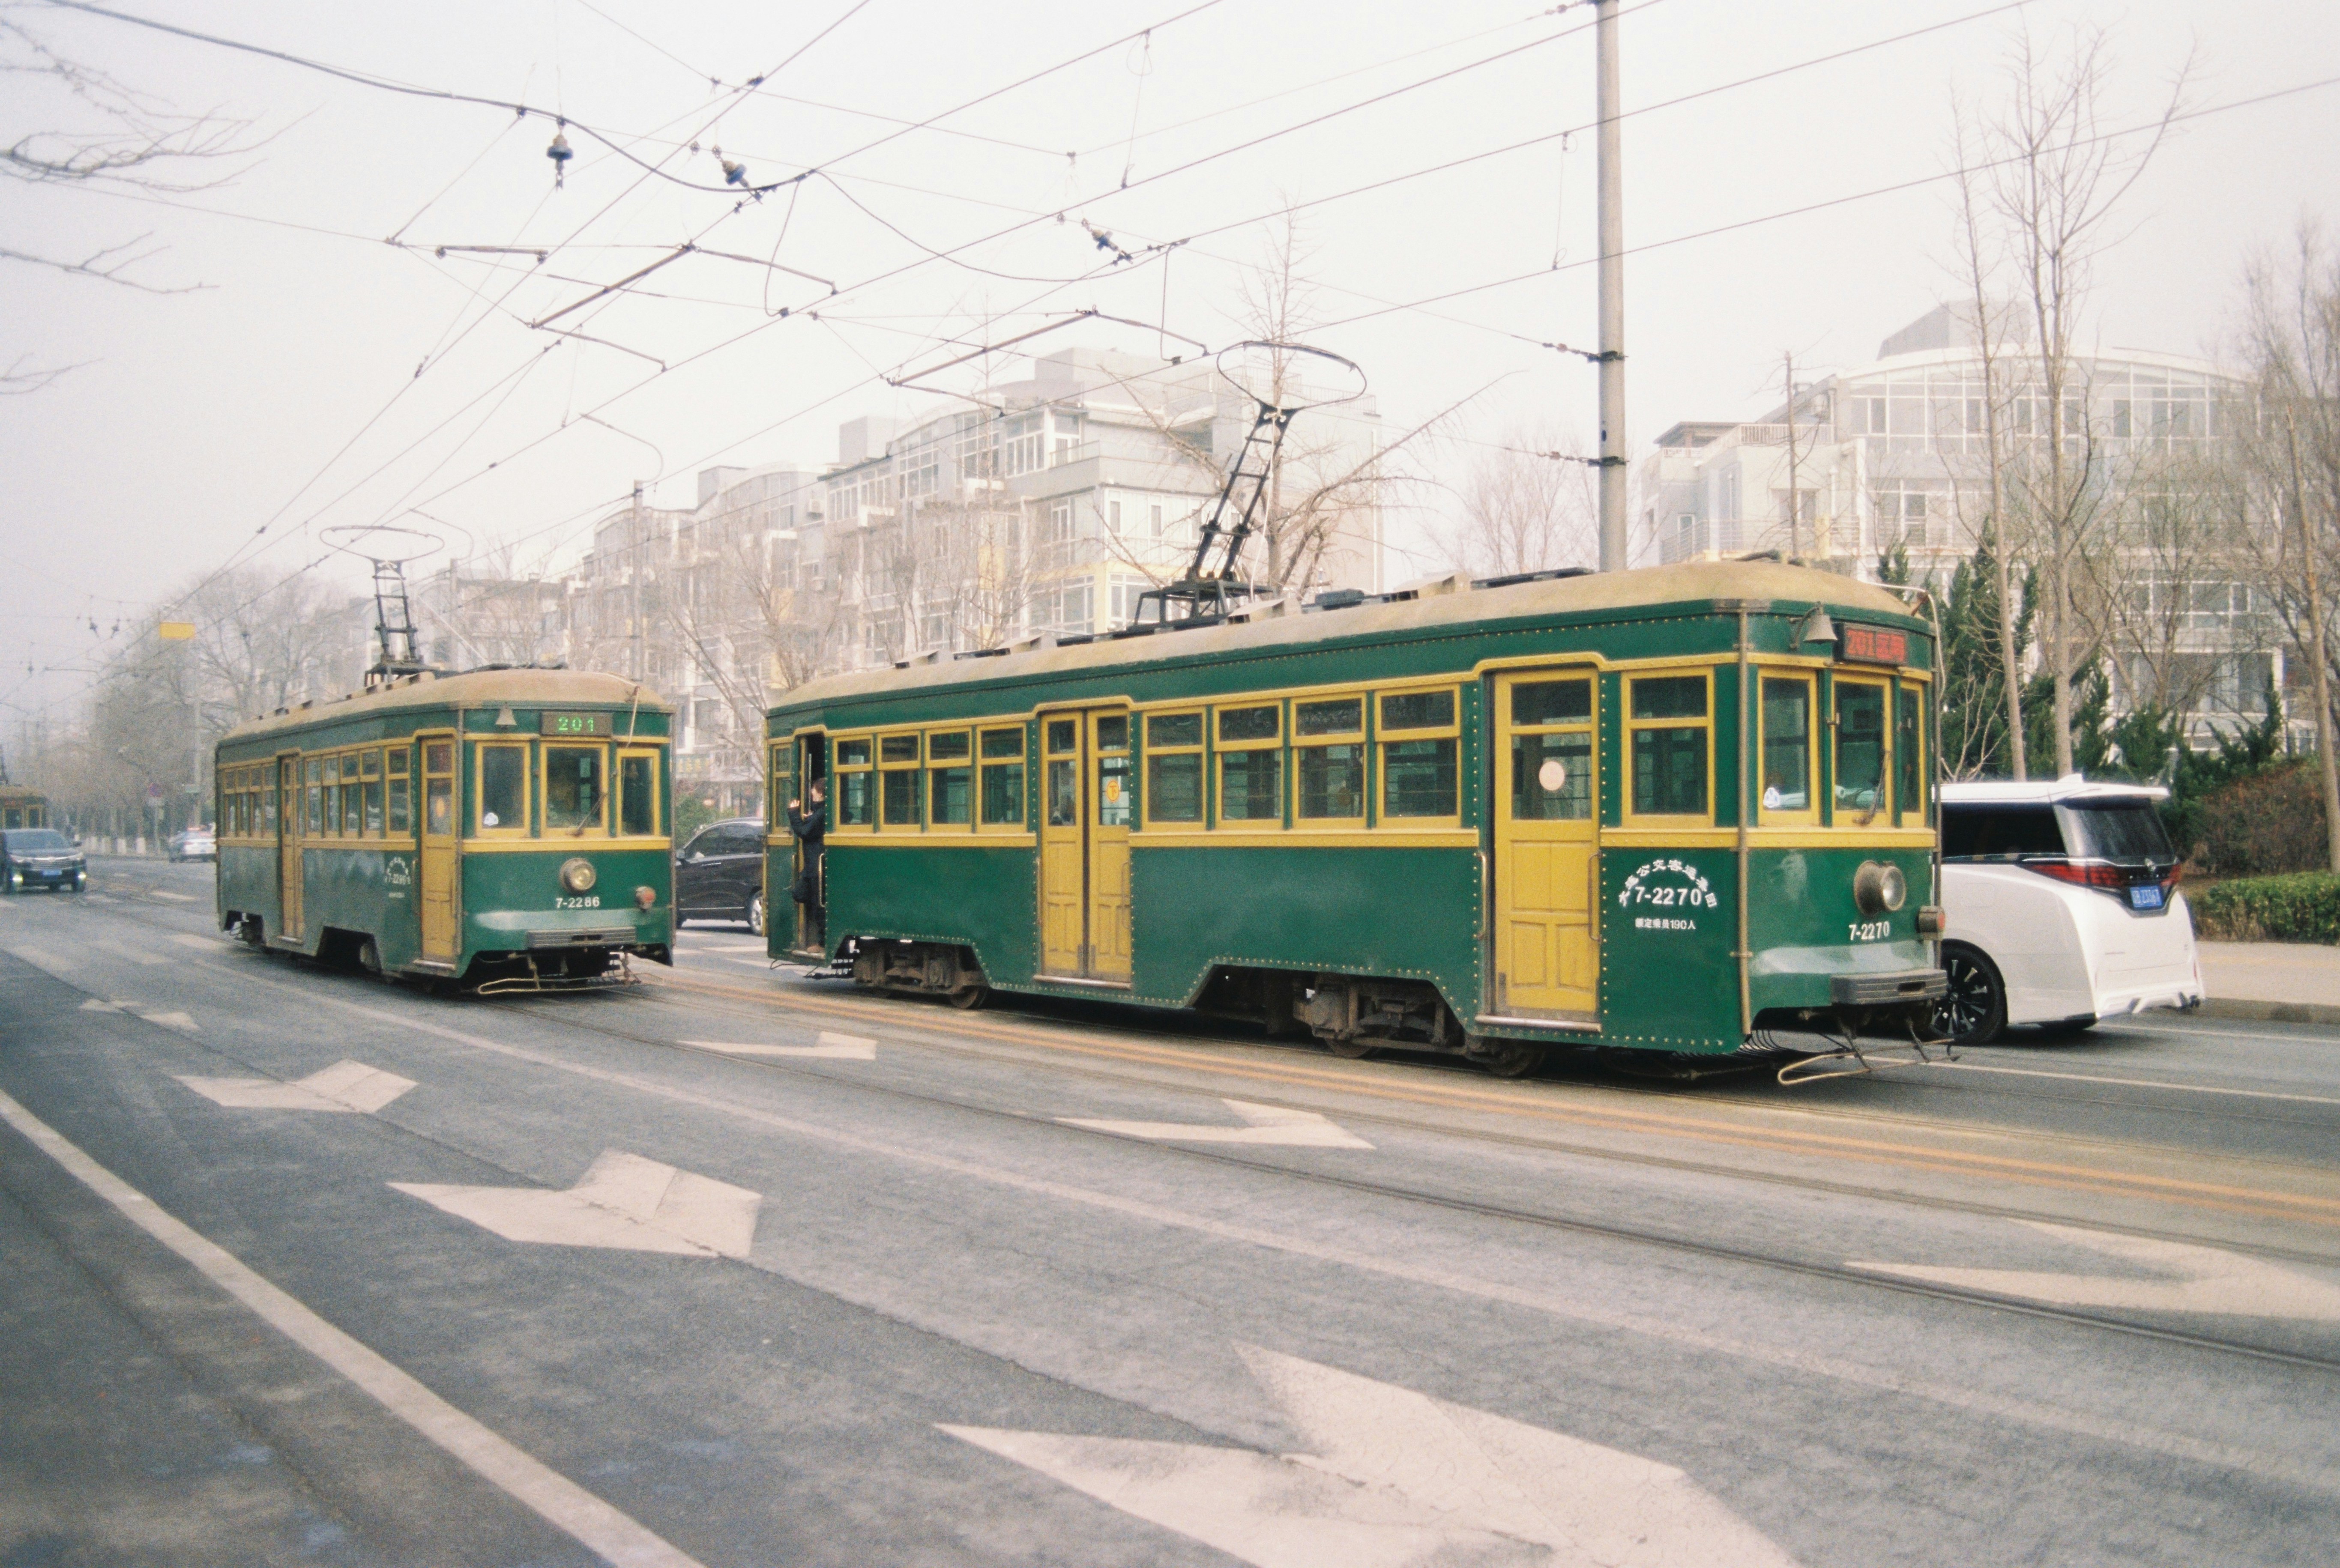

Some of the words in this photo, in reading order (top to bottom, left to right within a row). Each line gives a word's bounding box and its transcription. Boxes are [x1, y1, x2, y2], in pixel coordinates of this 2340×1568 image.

[558, 717, 594, 731] 201
[556, 896, 600, 908] 7-2286
[1635, 887, 1702, 905] 7-2270
[1849, 921, 1890, 941] 7-2270
